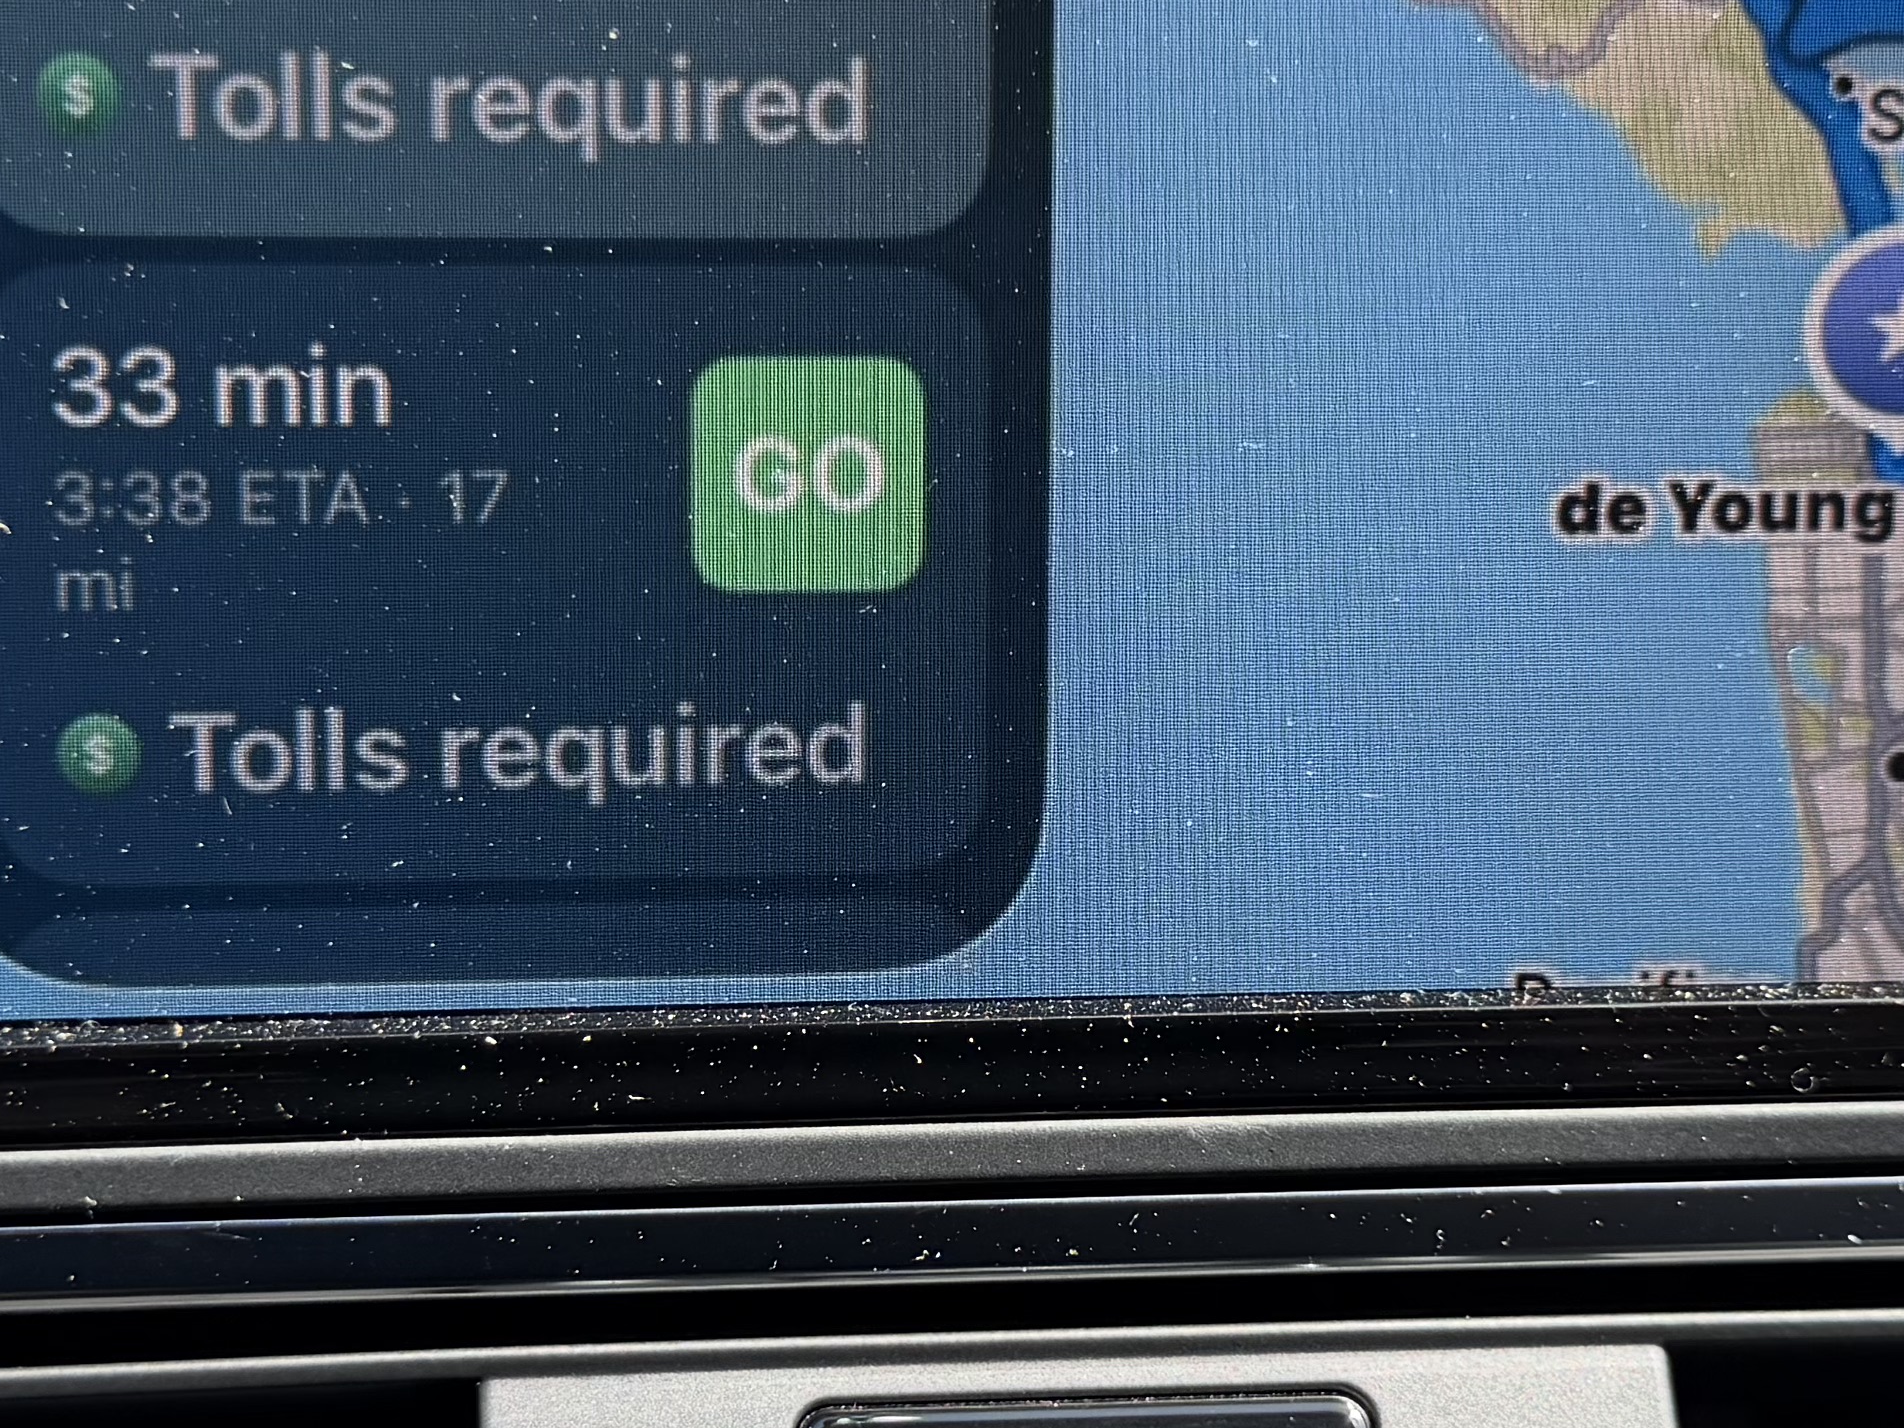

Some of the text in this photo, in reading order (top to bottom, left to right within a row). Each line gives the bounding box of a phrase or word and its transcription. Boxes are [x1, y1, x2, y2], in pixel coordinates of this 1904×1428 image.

[147, 49, 869, 163] Tolls required
[52, 340, 393, 428] 33 min
[53, 468, 508, 526] 3:38 ETA 17
[736, 433, 886, 514] GO
[1554, 482, 1647, 536] de
[1668, 481, 1895, 542] Young
[55, 556, 134, 612] mi
[168, 698, 866, 807] Tolls required
